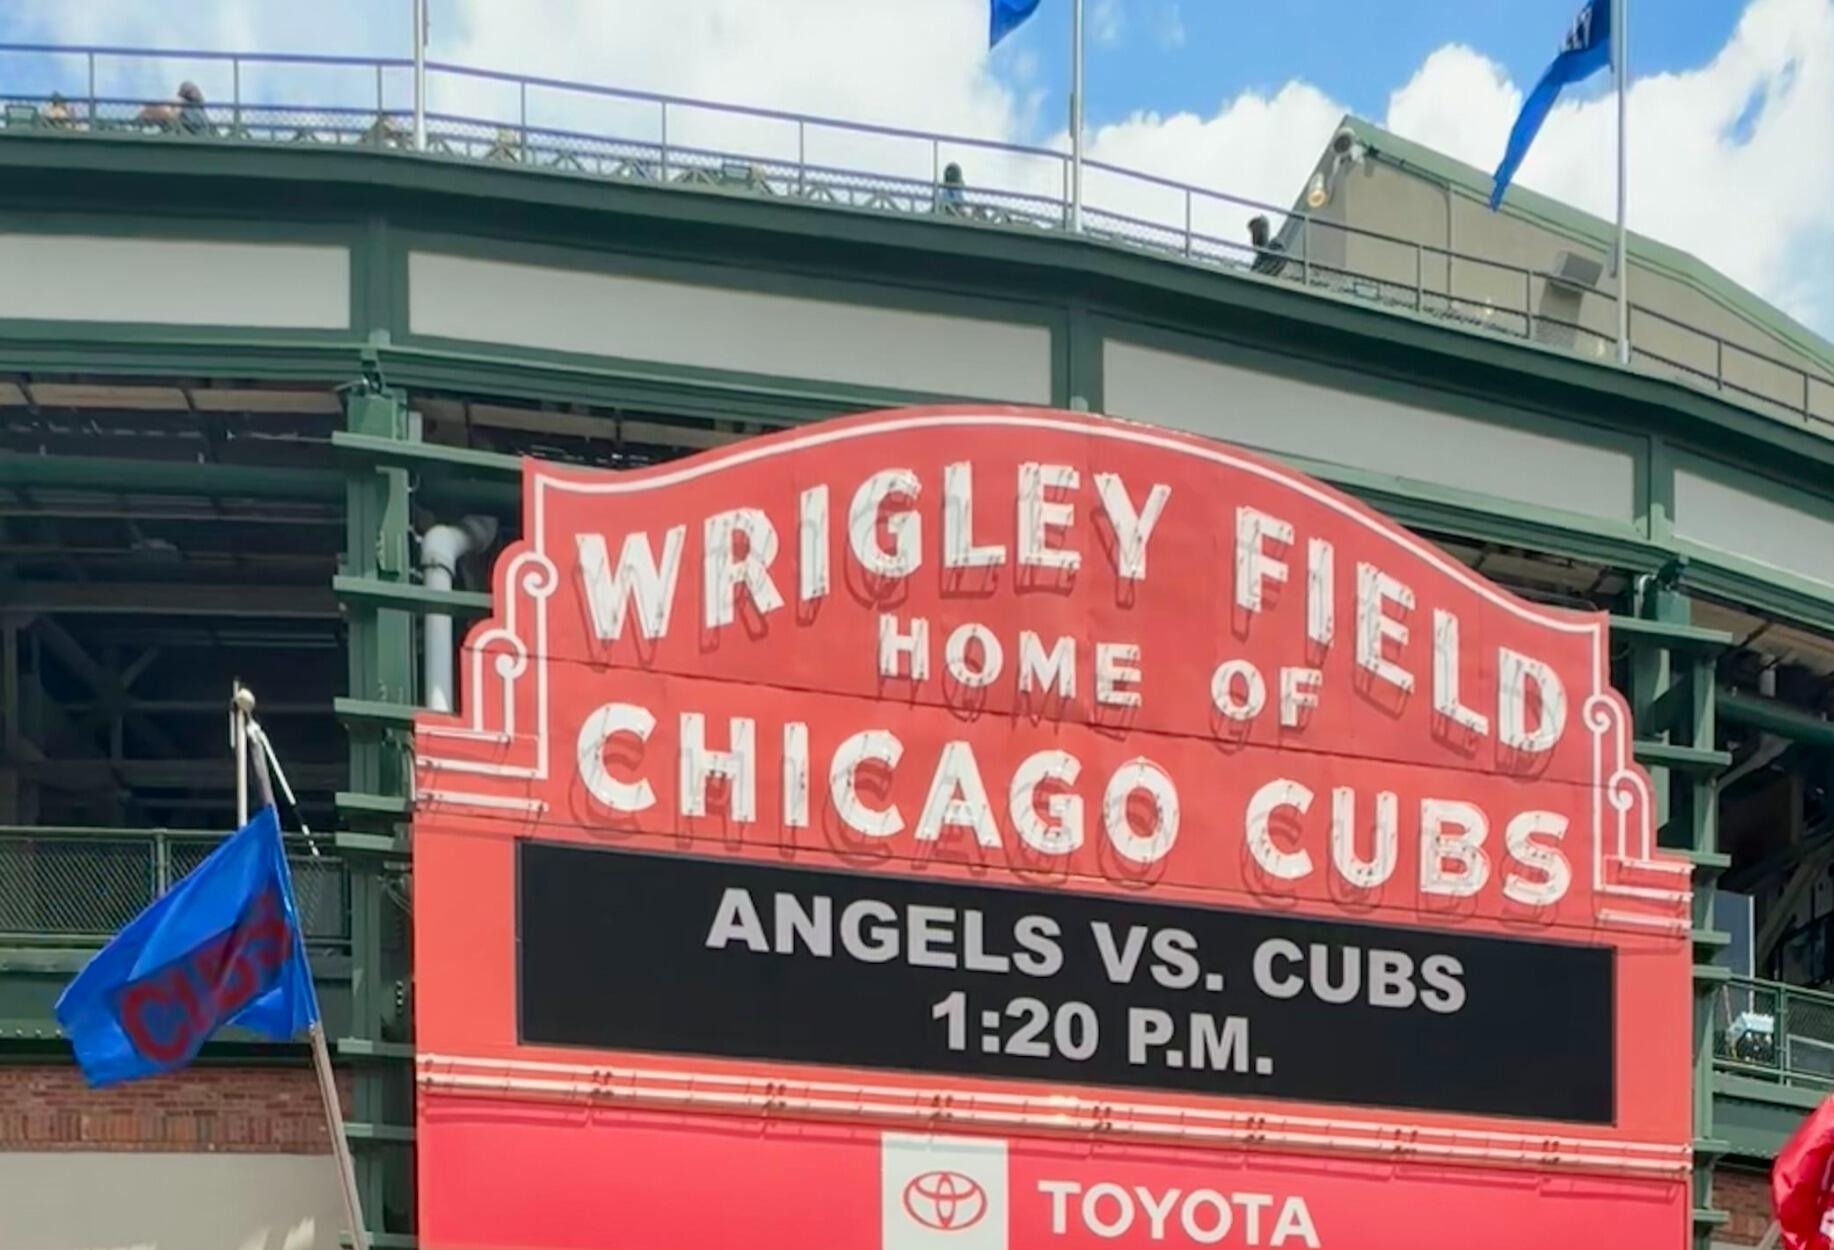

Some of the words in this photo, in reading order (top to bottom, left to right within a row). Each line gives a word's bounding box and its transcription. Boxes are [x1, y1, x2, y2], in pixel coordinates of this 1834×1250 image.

[576, 461, 1171, 641] WRIGLEY
[1235, 507, 1568, 754] FIELD
[879, 614, 1141, 707] HOME
[1211, 660, 1321, 727] OF
[577, 703, 1181, 864] CHICAGO
[1245, 779, 1572, 906] CUBS
[706, 888, 1063, 978] ANGELS
[1091, 922, 1223, 995] VS.
[1253, 939, 1466, 1013] CUBS
[932, 992, 1099, 1060] 1:20
[1128, 1007, 1274, 1075] P.M.
[1038, 1180, 1321, 1249] TOYOTA
